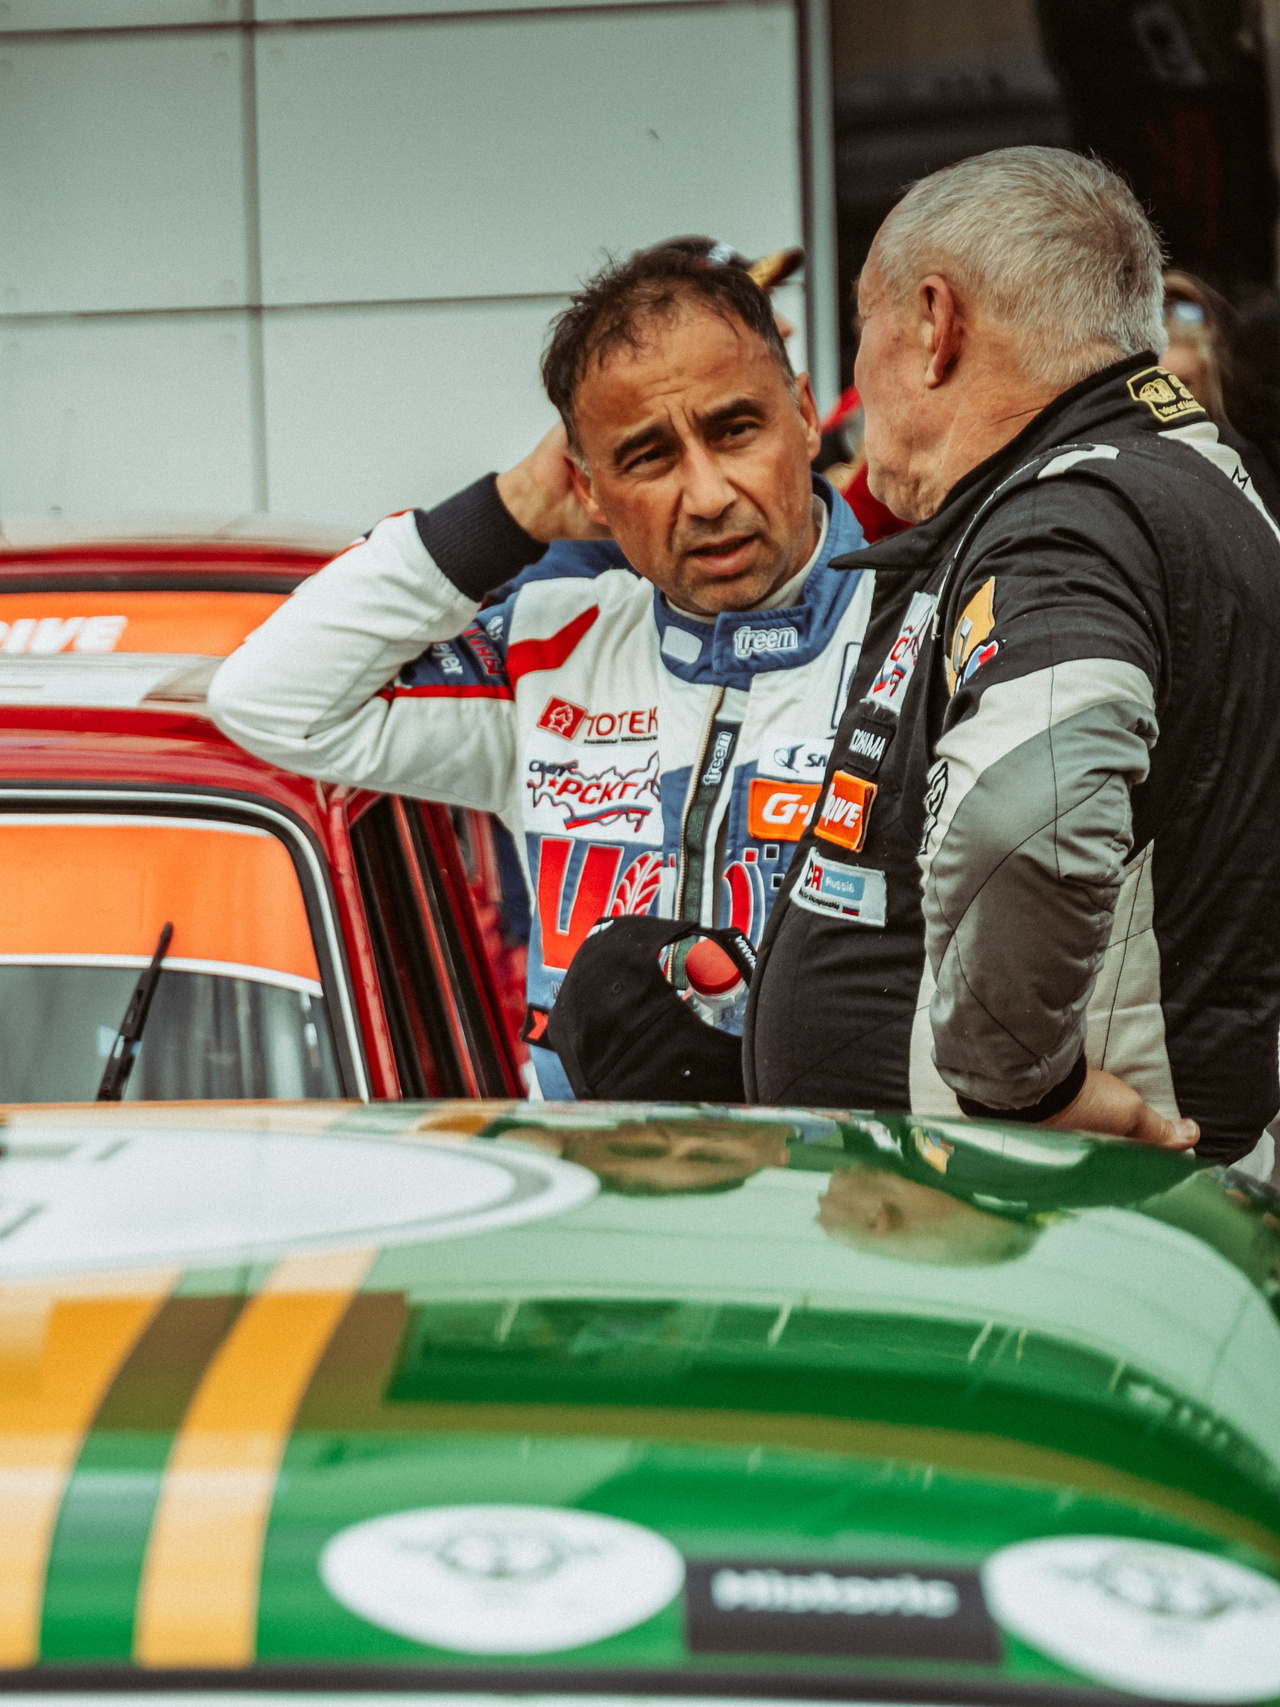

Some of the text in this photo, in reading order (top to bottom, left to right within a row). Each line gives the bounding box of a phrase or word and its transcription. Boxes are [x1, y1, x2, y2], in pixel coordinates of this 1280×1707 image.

[735, 627, 798, 657] freem
[703, 731, 733, 786] freem
[825, 876, 856, 893] Russia
